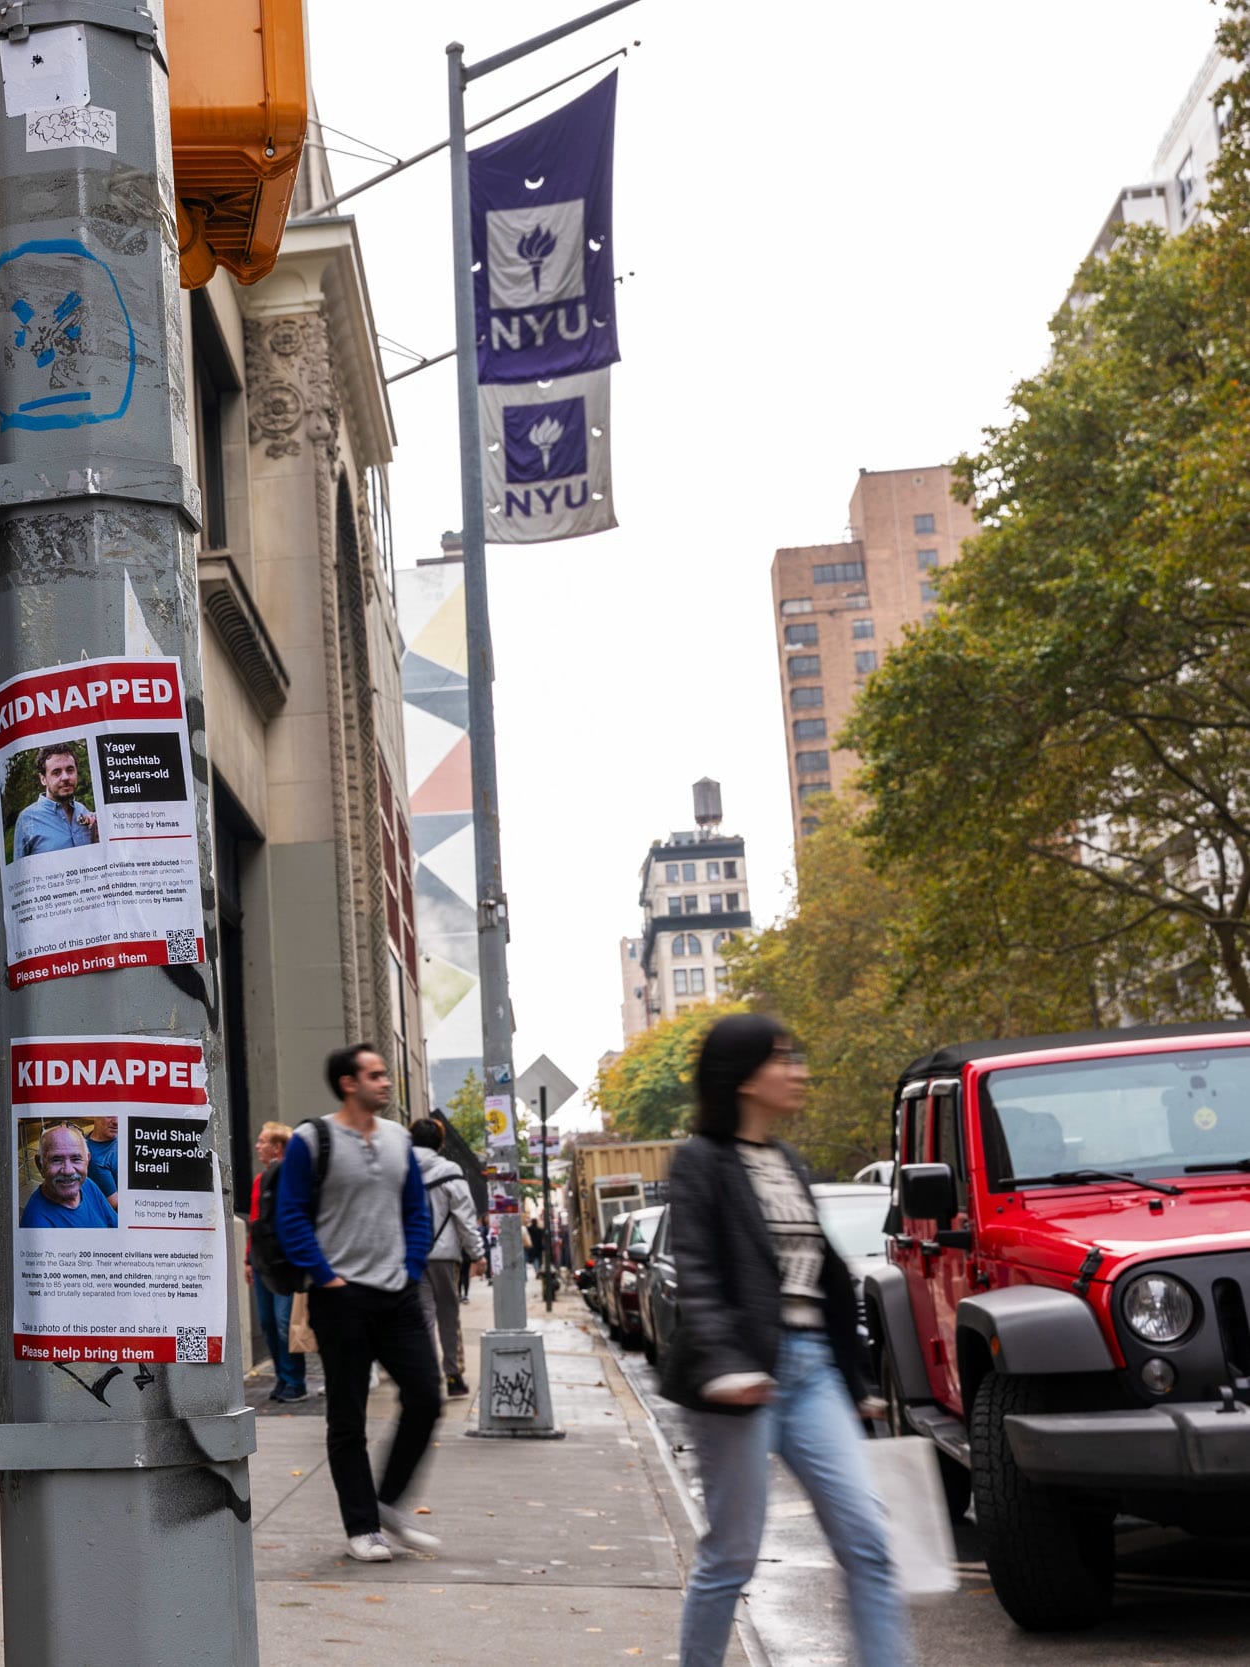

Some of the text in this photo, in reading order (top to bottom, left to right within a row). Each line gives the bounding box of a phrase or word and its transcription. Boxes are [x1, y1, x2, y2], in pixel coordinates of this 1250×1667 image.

[490, 304, 589, 351] NYU
[504, 479, 589, 518] NYU
[104, 742, 136, 754] Yagev
[106, 755, 160, 767] Buchshtab
[108, 769, 170, 782] 34-years-old
[110, 784, 141, 795] Israeli
[113, 809, 166, 821] Kidnapped from
[114, 819, 179, 830] his home by Hamas
[34, 943, 56, 955] photo
[58, 941, 67, 949] of
[69, 937, 83, 948] this
[85, 934, 110, 946] poster
[113, 931, 128, 940] and
[130, 930, 150, 939] share
[16, 953, 147, 983] Please help bring them
[134, 1128, 167, 1141] David
[134, 1161, 170, 1174] Israeli
[134, 1199, 190, 1209] Kidnapped from
[134, 1210, 203, 1220] his home by Hamas
[39, 1323, 168, 1334] photo of this poster and share it
[21, 1345, 154, 1361] Please help bring them
